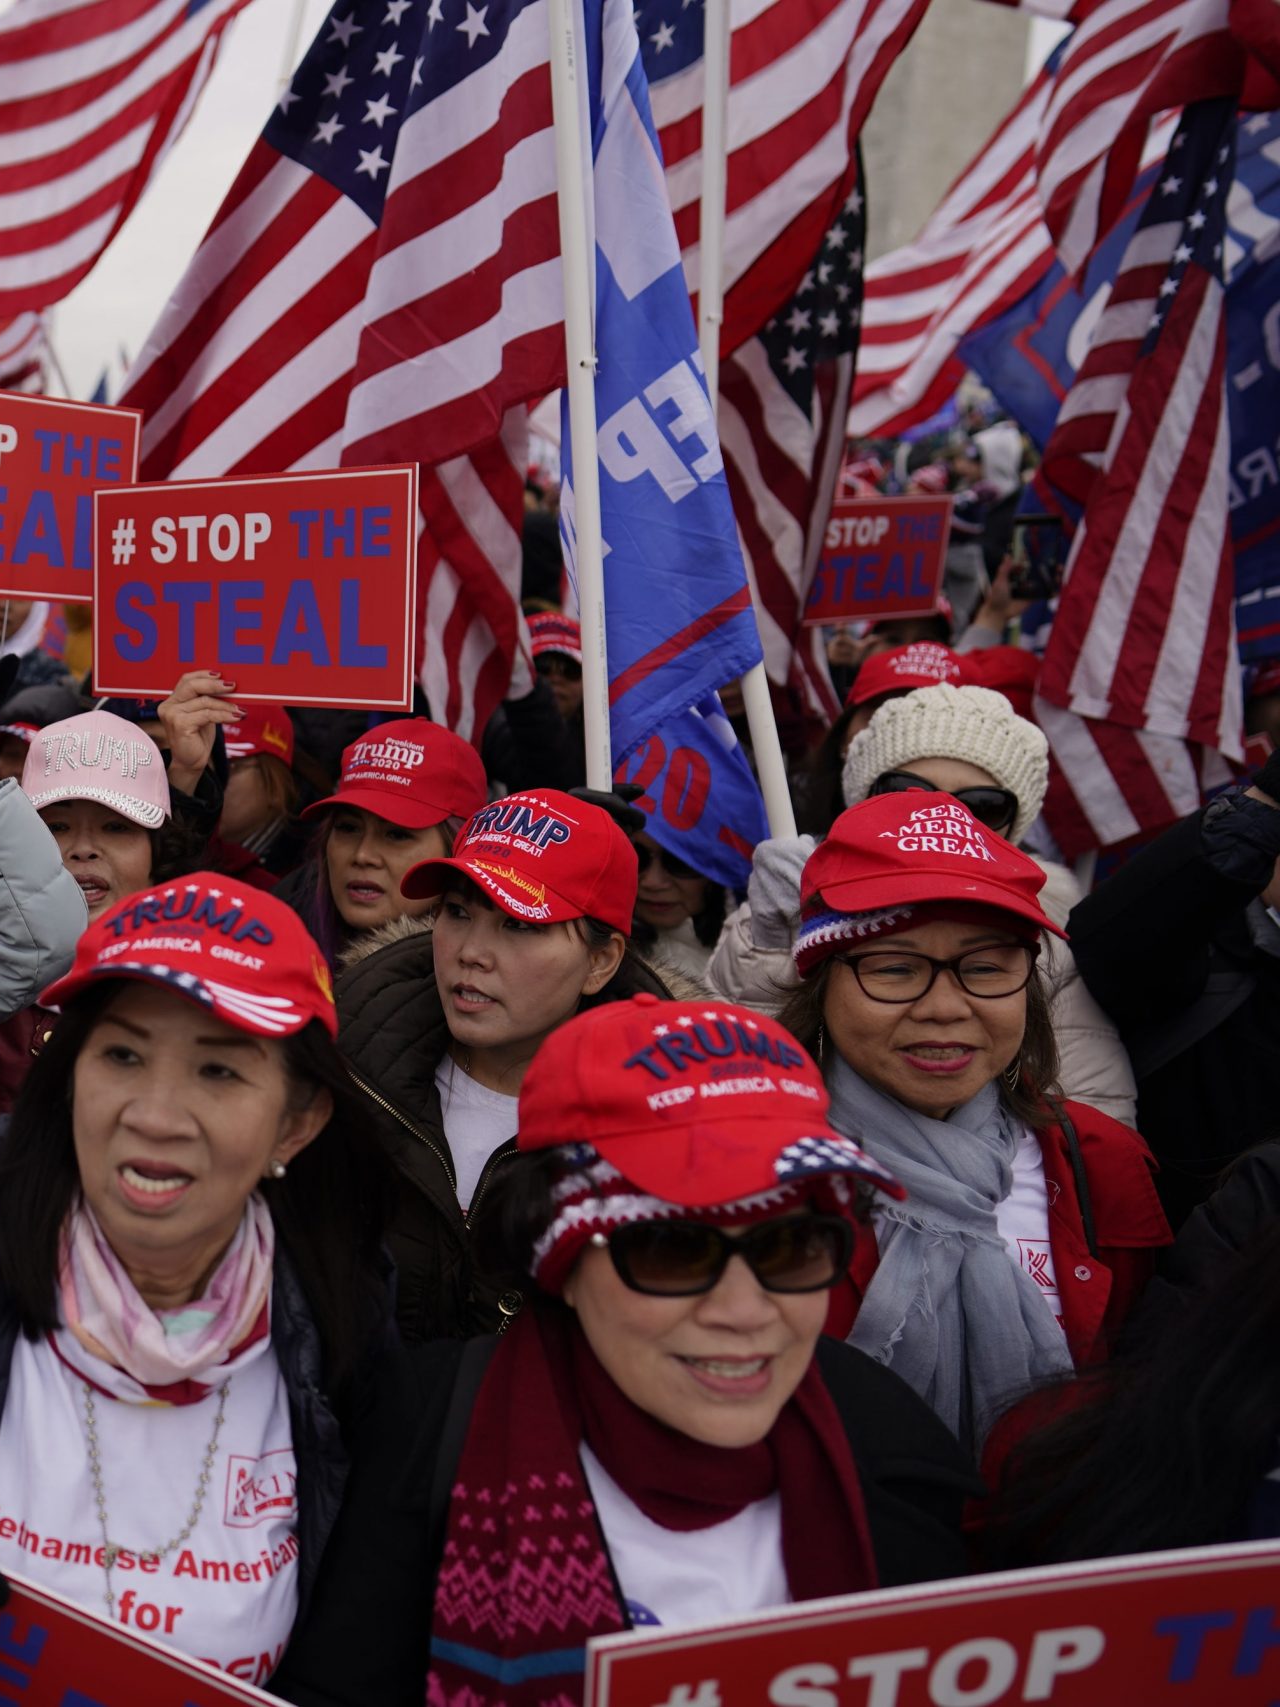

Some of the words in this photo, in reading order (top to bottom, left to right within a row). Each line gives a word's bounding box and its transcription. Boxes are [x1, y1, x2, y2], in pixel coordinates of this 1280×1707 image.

[35, 429, 121, 481] THE
[151, 512, 272, 564] STOP
[289, 507, 392, 558] THE
[826, 515, 890, 549] STOP
[896, 514, 942, 544] THE
[113, 579, 389, 669] STEAL
[41, 730, 152, 780] TRUMP
[350, 742, 424, 769] Trump
[385, 737, 424, 752] President
[370, 758, 401, 770] 2020
[386, 774, 412, 786] GREAT
[465, 805, 570, 849] TRUMP
[878, 820, 987, 843] AMERIC
[910, 804, 973, 825] KEEP
[474, 844, 511, 858] 2020
[479, 833, 511, 846] AMERICA
[513, 839, 544, 857] GREAT!
[897, 836, 997, 862] GREAT
[103, 891, 275, 946] TRUMP
[496, 887, 552, 919] PRESIDENT
[97, 941, 130, 963] KEEP
[130, 937, 202, 954] AMERICA
[209, 945, 266, 971] GREAT
[624, 1021, 805, 1081] TRUMP
[646, 1085, 696, 1111] KEEP
[699, 1077, 778, 1098] AMERICA
[118, 1591, 183, 1634] for
[767, 1625, 1106, 1707] STOP
[1154, 1607, 1280, 1683] TH
